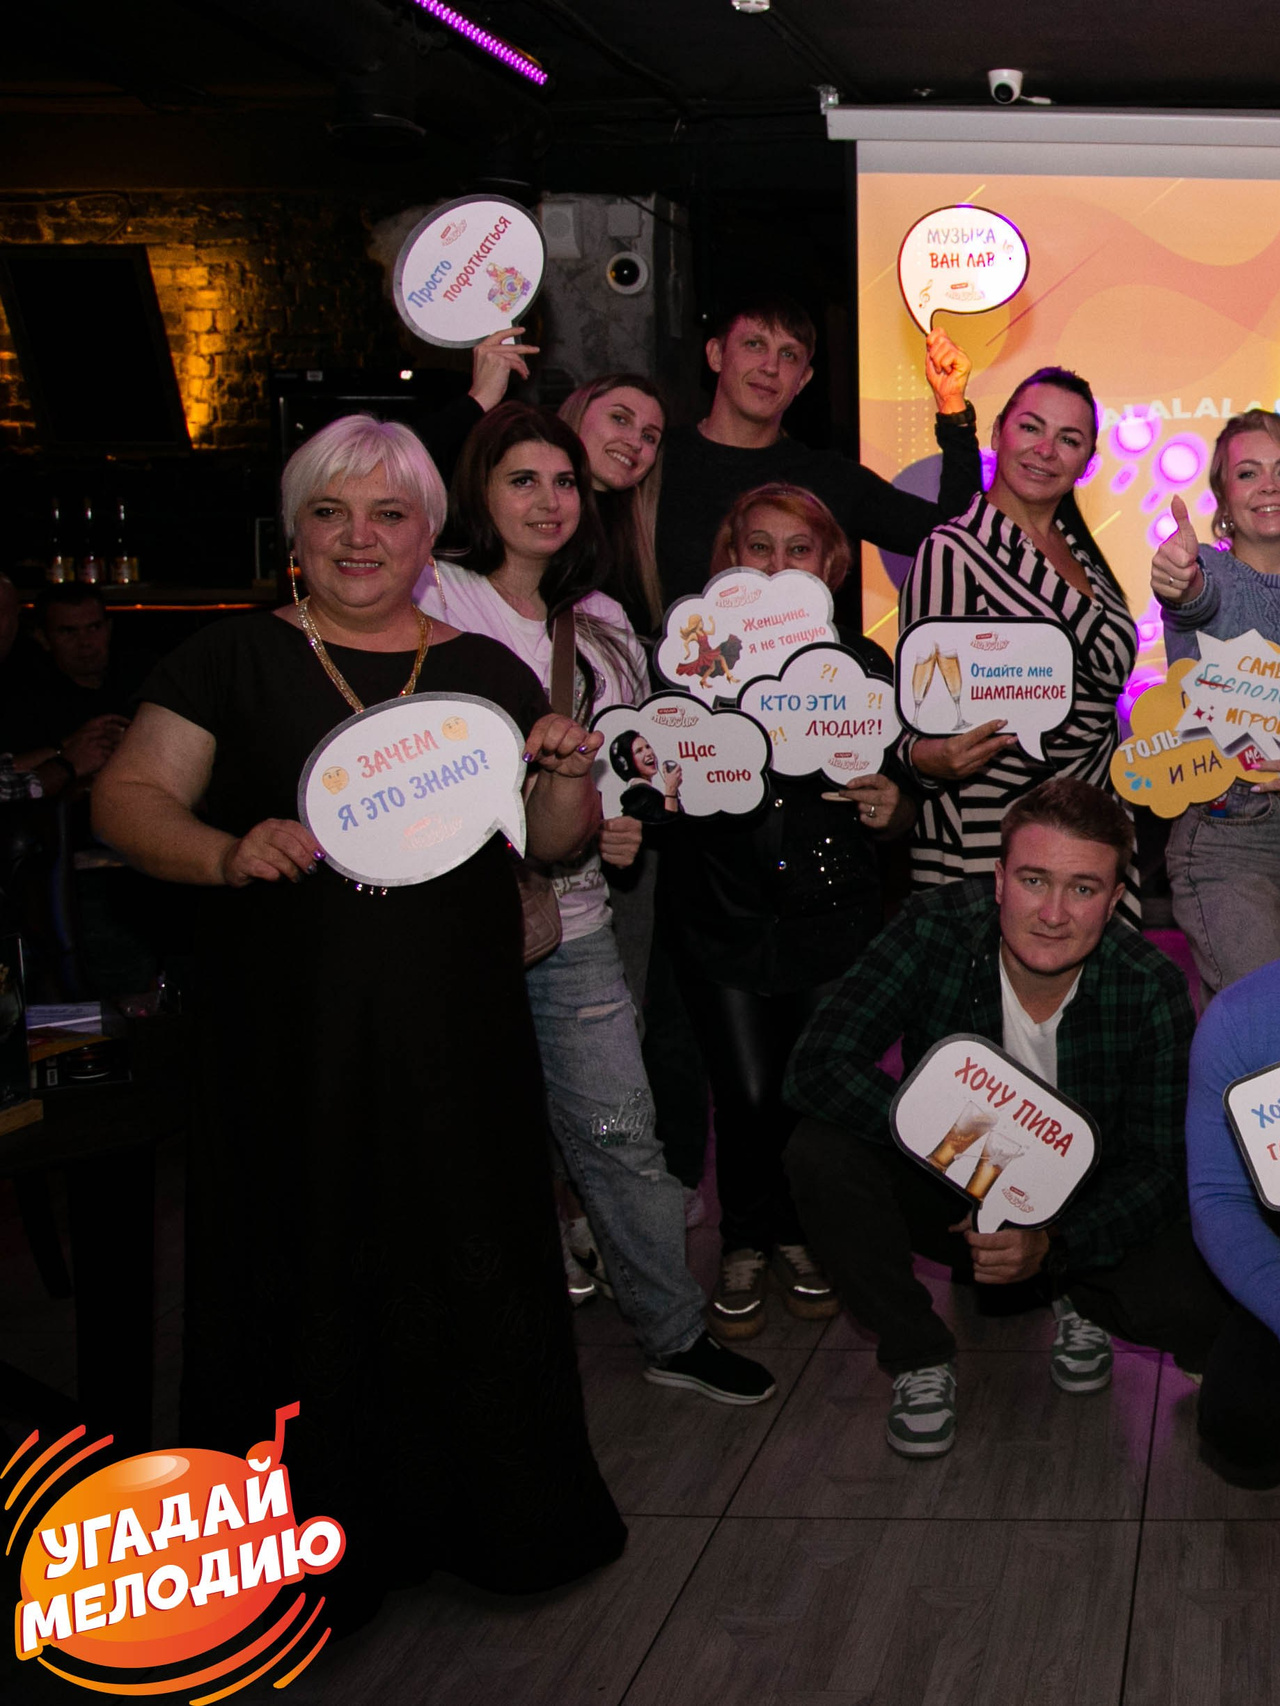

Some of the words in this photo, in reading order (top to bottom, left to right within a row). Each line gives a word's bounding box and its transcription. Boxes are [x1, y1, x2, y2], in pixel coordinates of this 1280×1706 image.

[443, 215, 512, 302] пофоткаться
[929, 252, 960, 268] ВАН
[966, 251, 995, 268] ЛАВ
[407, 260, 453, 308] Просто
[749, 643, 758, 654] я
[760, 637, 776, 651] не
[777, 625, 827, 647] танцую
[820, 663, 838, 683] ?!
[970, 662, 1023, 678] Отдайте
[1027, 666, 1053, 678] мне
[867, 692, 884, 710] ?!
[970, 684, 1067, 700] ШАМПАНСКОЕ
[760, 694, 801, 711] КТО
[805, 694, 847, 711] ЭТИ
[805, 719, 883, 738] ЛЮДИ?!
[357, 729, 440, 779] ЗАЧЕМ
[678, 741, 717, 762] Щас
[706, 767, 752, 783] спою
[1169, 764, 1184, 784] И
[337, 803, 359, 831] Я
[360, 786, 406, 820] ЭТО
[409, 749, 490, 799] ЗНАЮ?
[955, 1056, 1016, 1108] ХОЧУ
[1012, 1098, 1074, 1157] ПИВА
